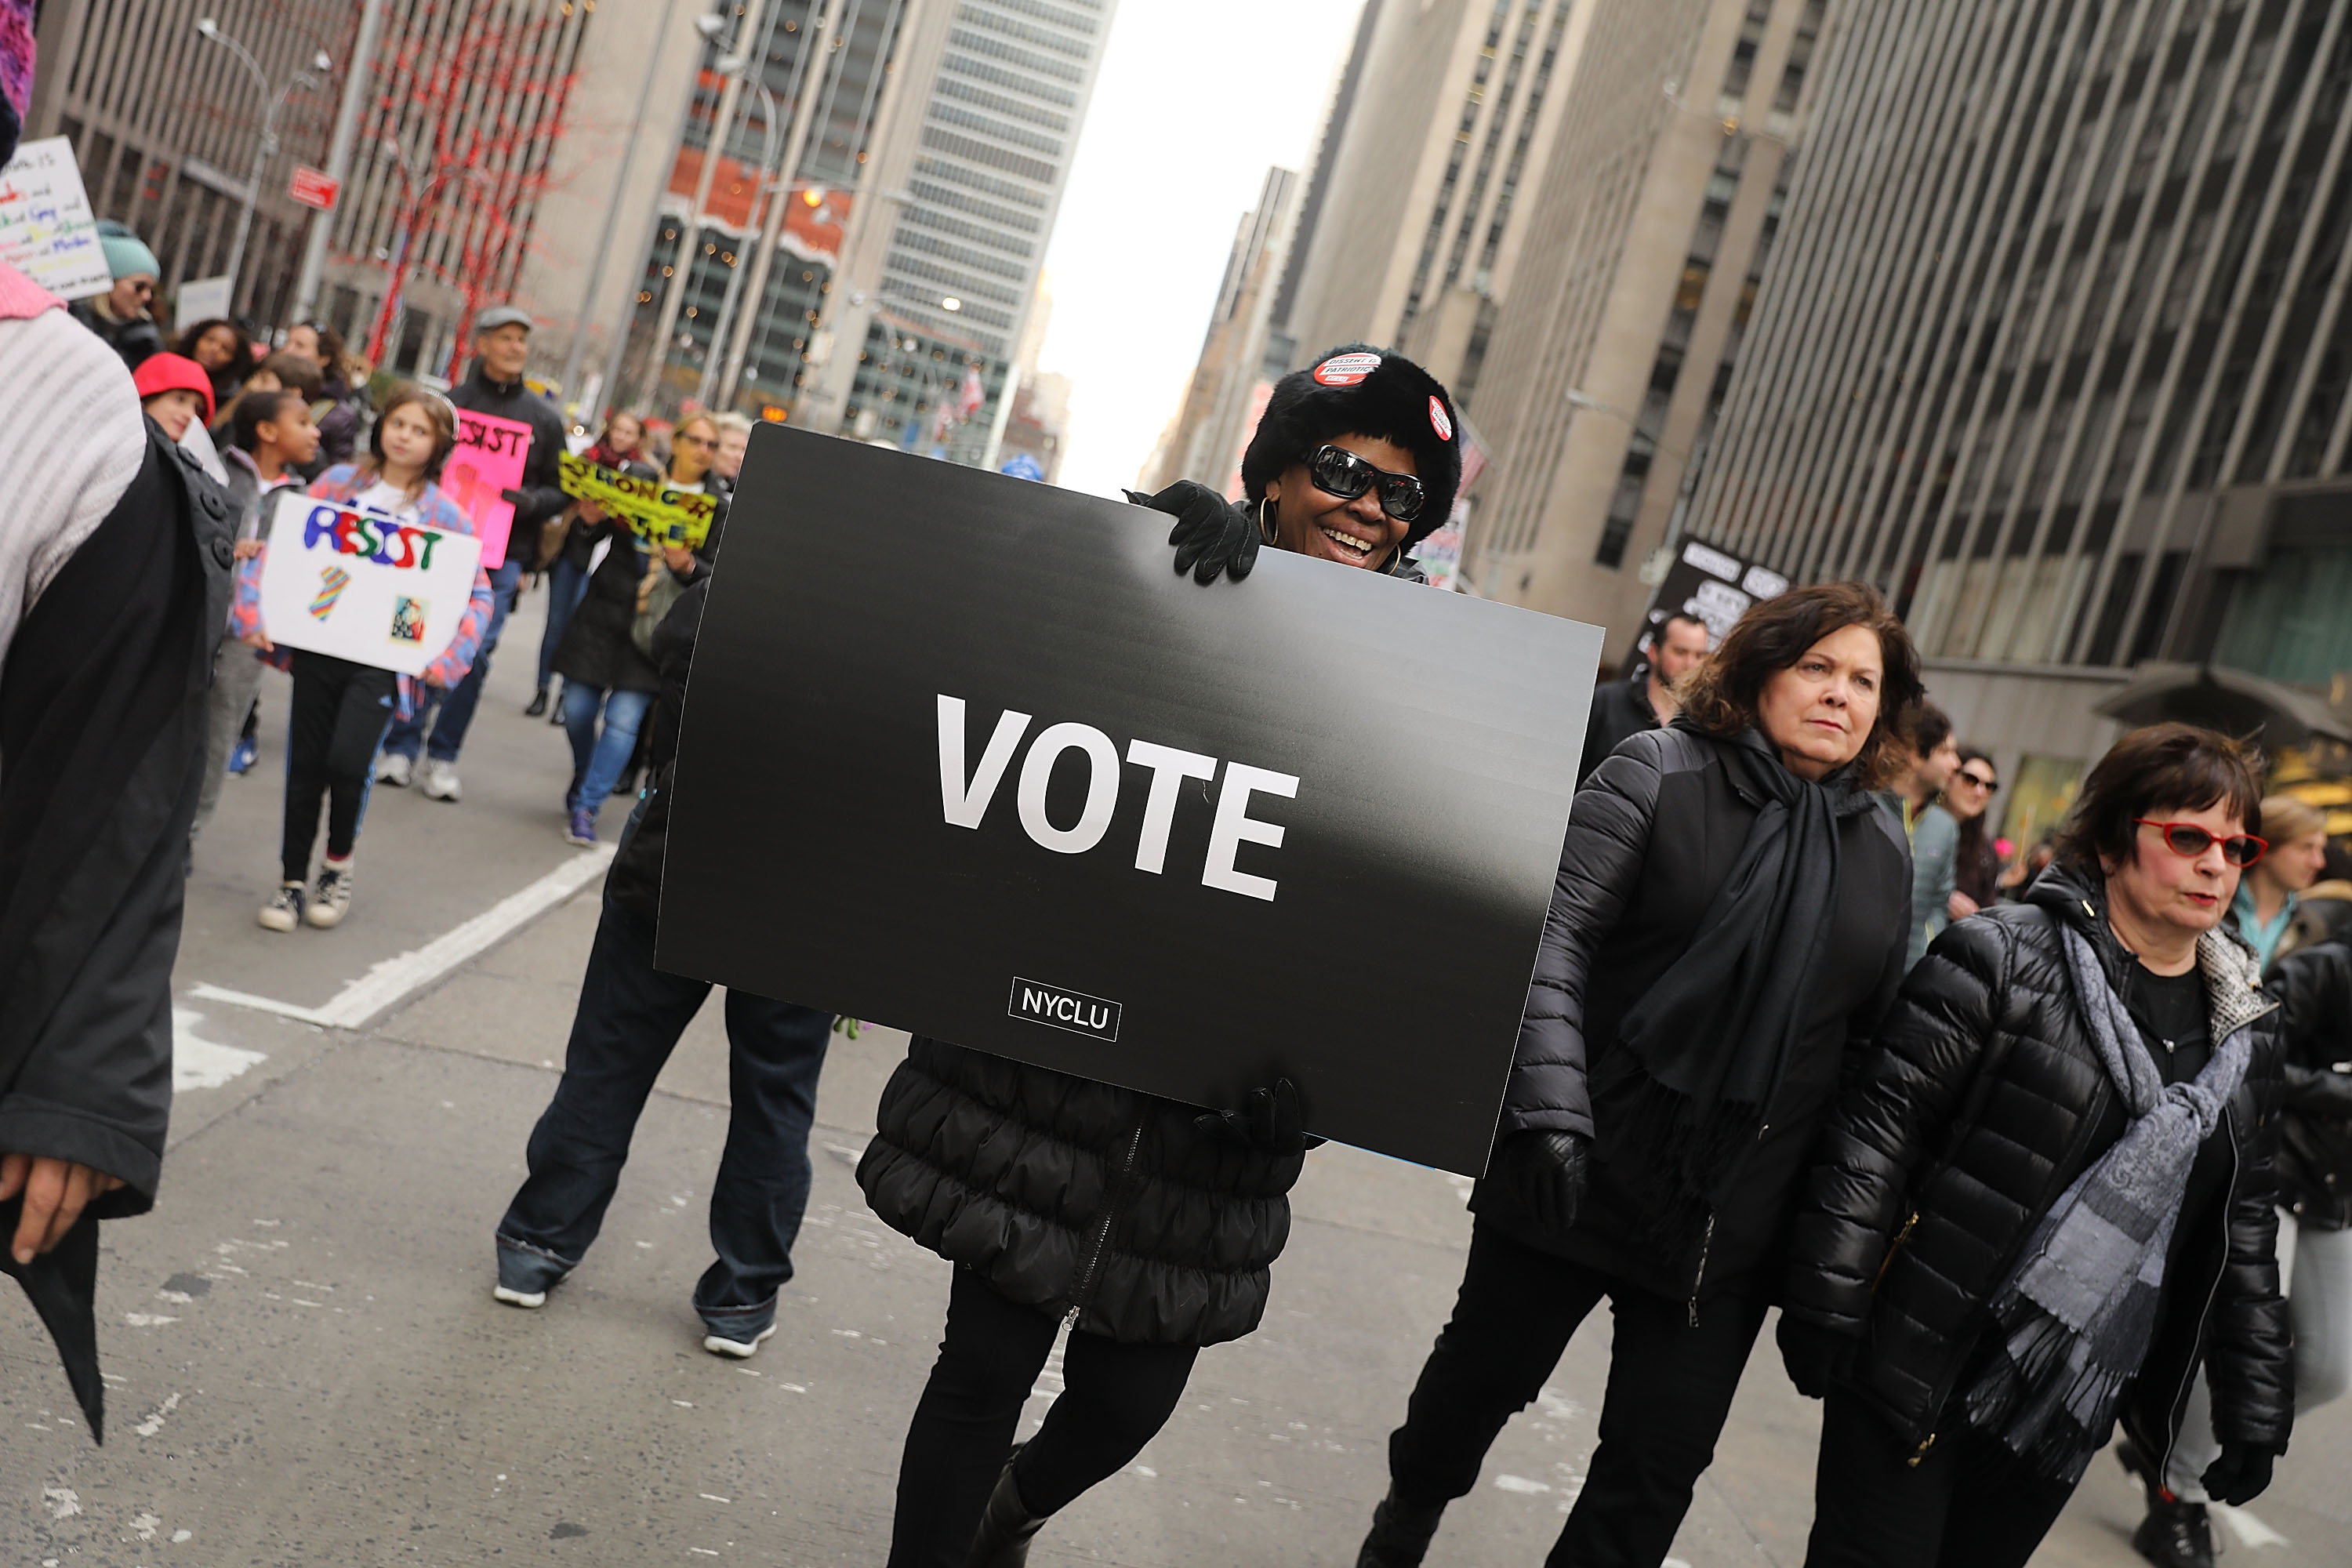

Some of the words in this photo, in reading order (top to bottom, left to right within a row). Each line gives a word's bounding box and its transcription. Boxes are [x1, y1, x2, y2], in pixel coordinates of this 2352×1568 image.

[304, 505, 442, 571] RESIST
[937, 693, 1301, 902] VOTE
[1022, 987, 1109, 1030] NYCLU
